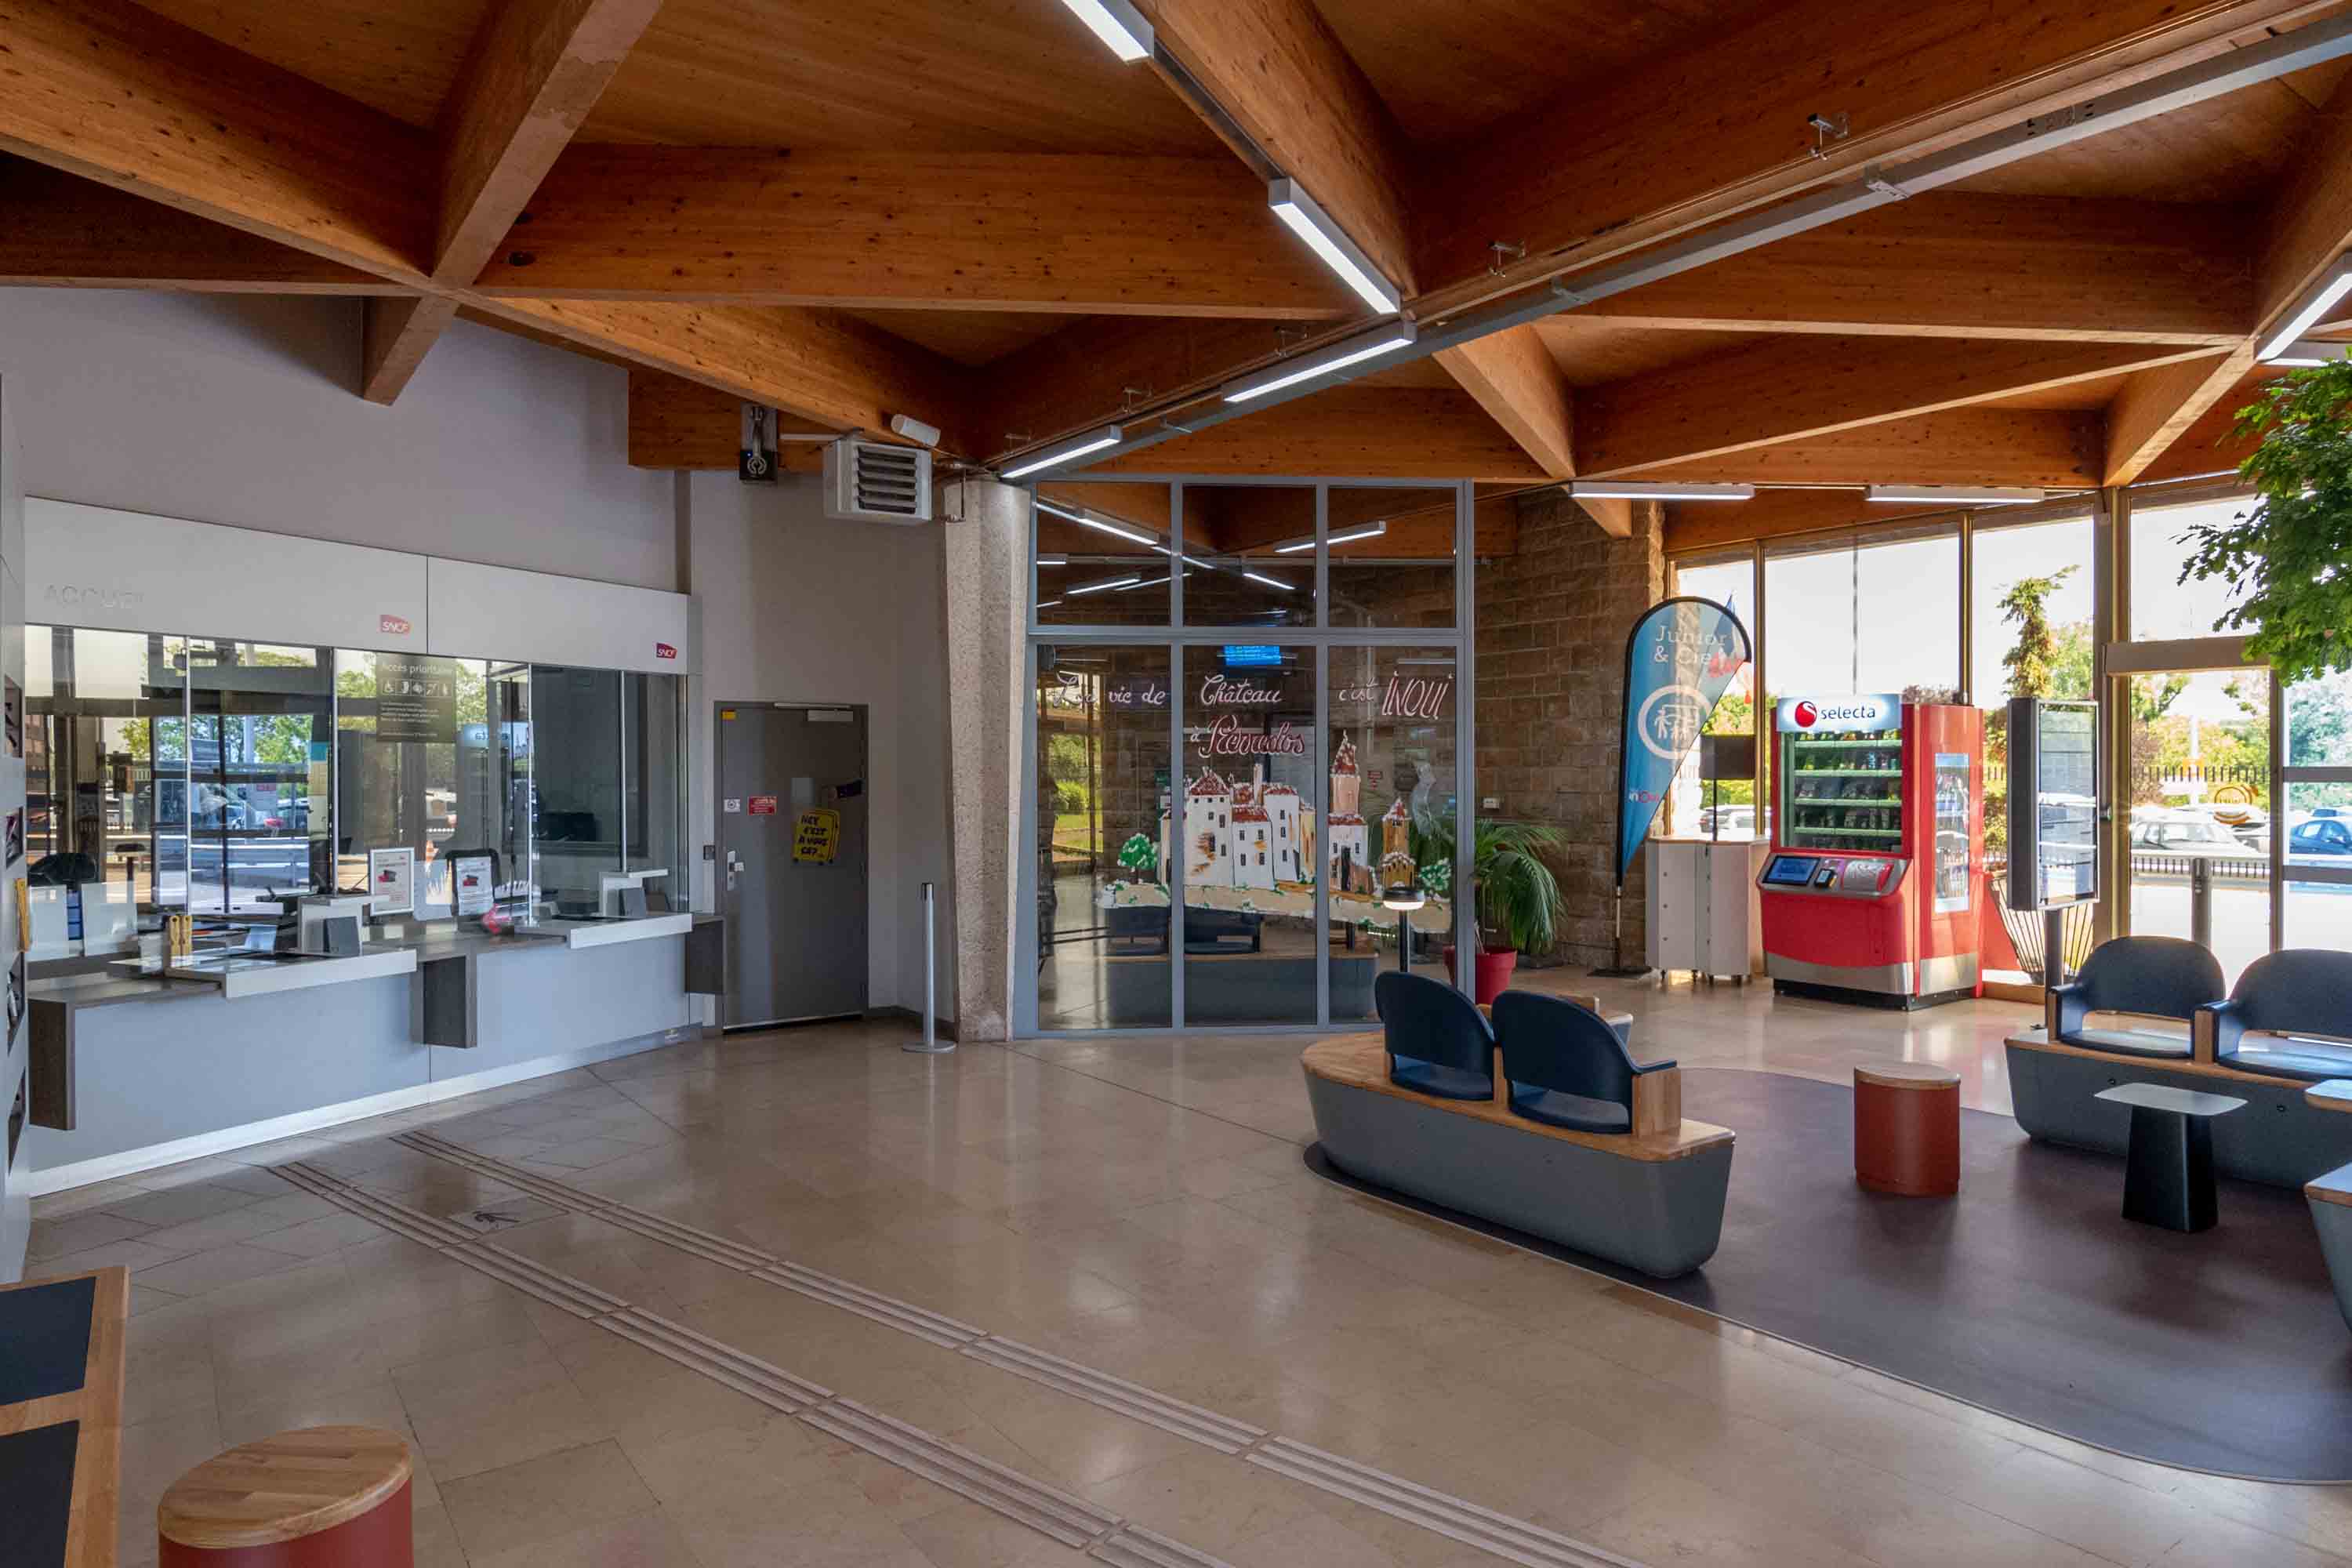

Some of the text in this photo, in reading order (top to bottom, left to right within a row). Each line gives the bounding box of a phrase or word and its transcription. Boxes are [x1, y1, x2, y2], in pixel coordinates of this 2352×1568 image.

[1655, 625, 1732, 646] Junior
[1654, 645, 1669, 663] &
[1108, 686, 1132, 704] vie
[1141, 683, 1167, 706] de
[1200, 673, 1283, 707] Château
[1820, 706, 1875, 720] selecta
